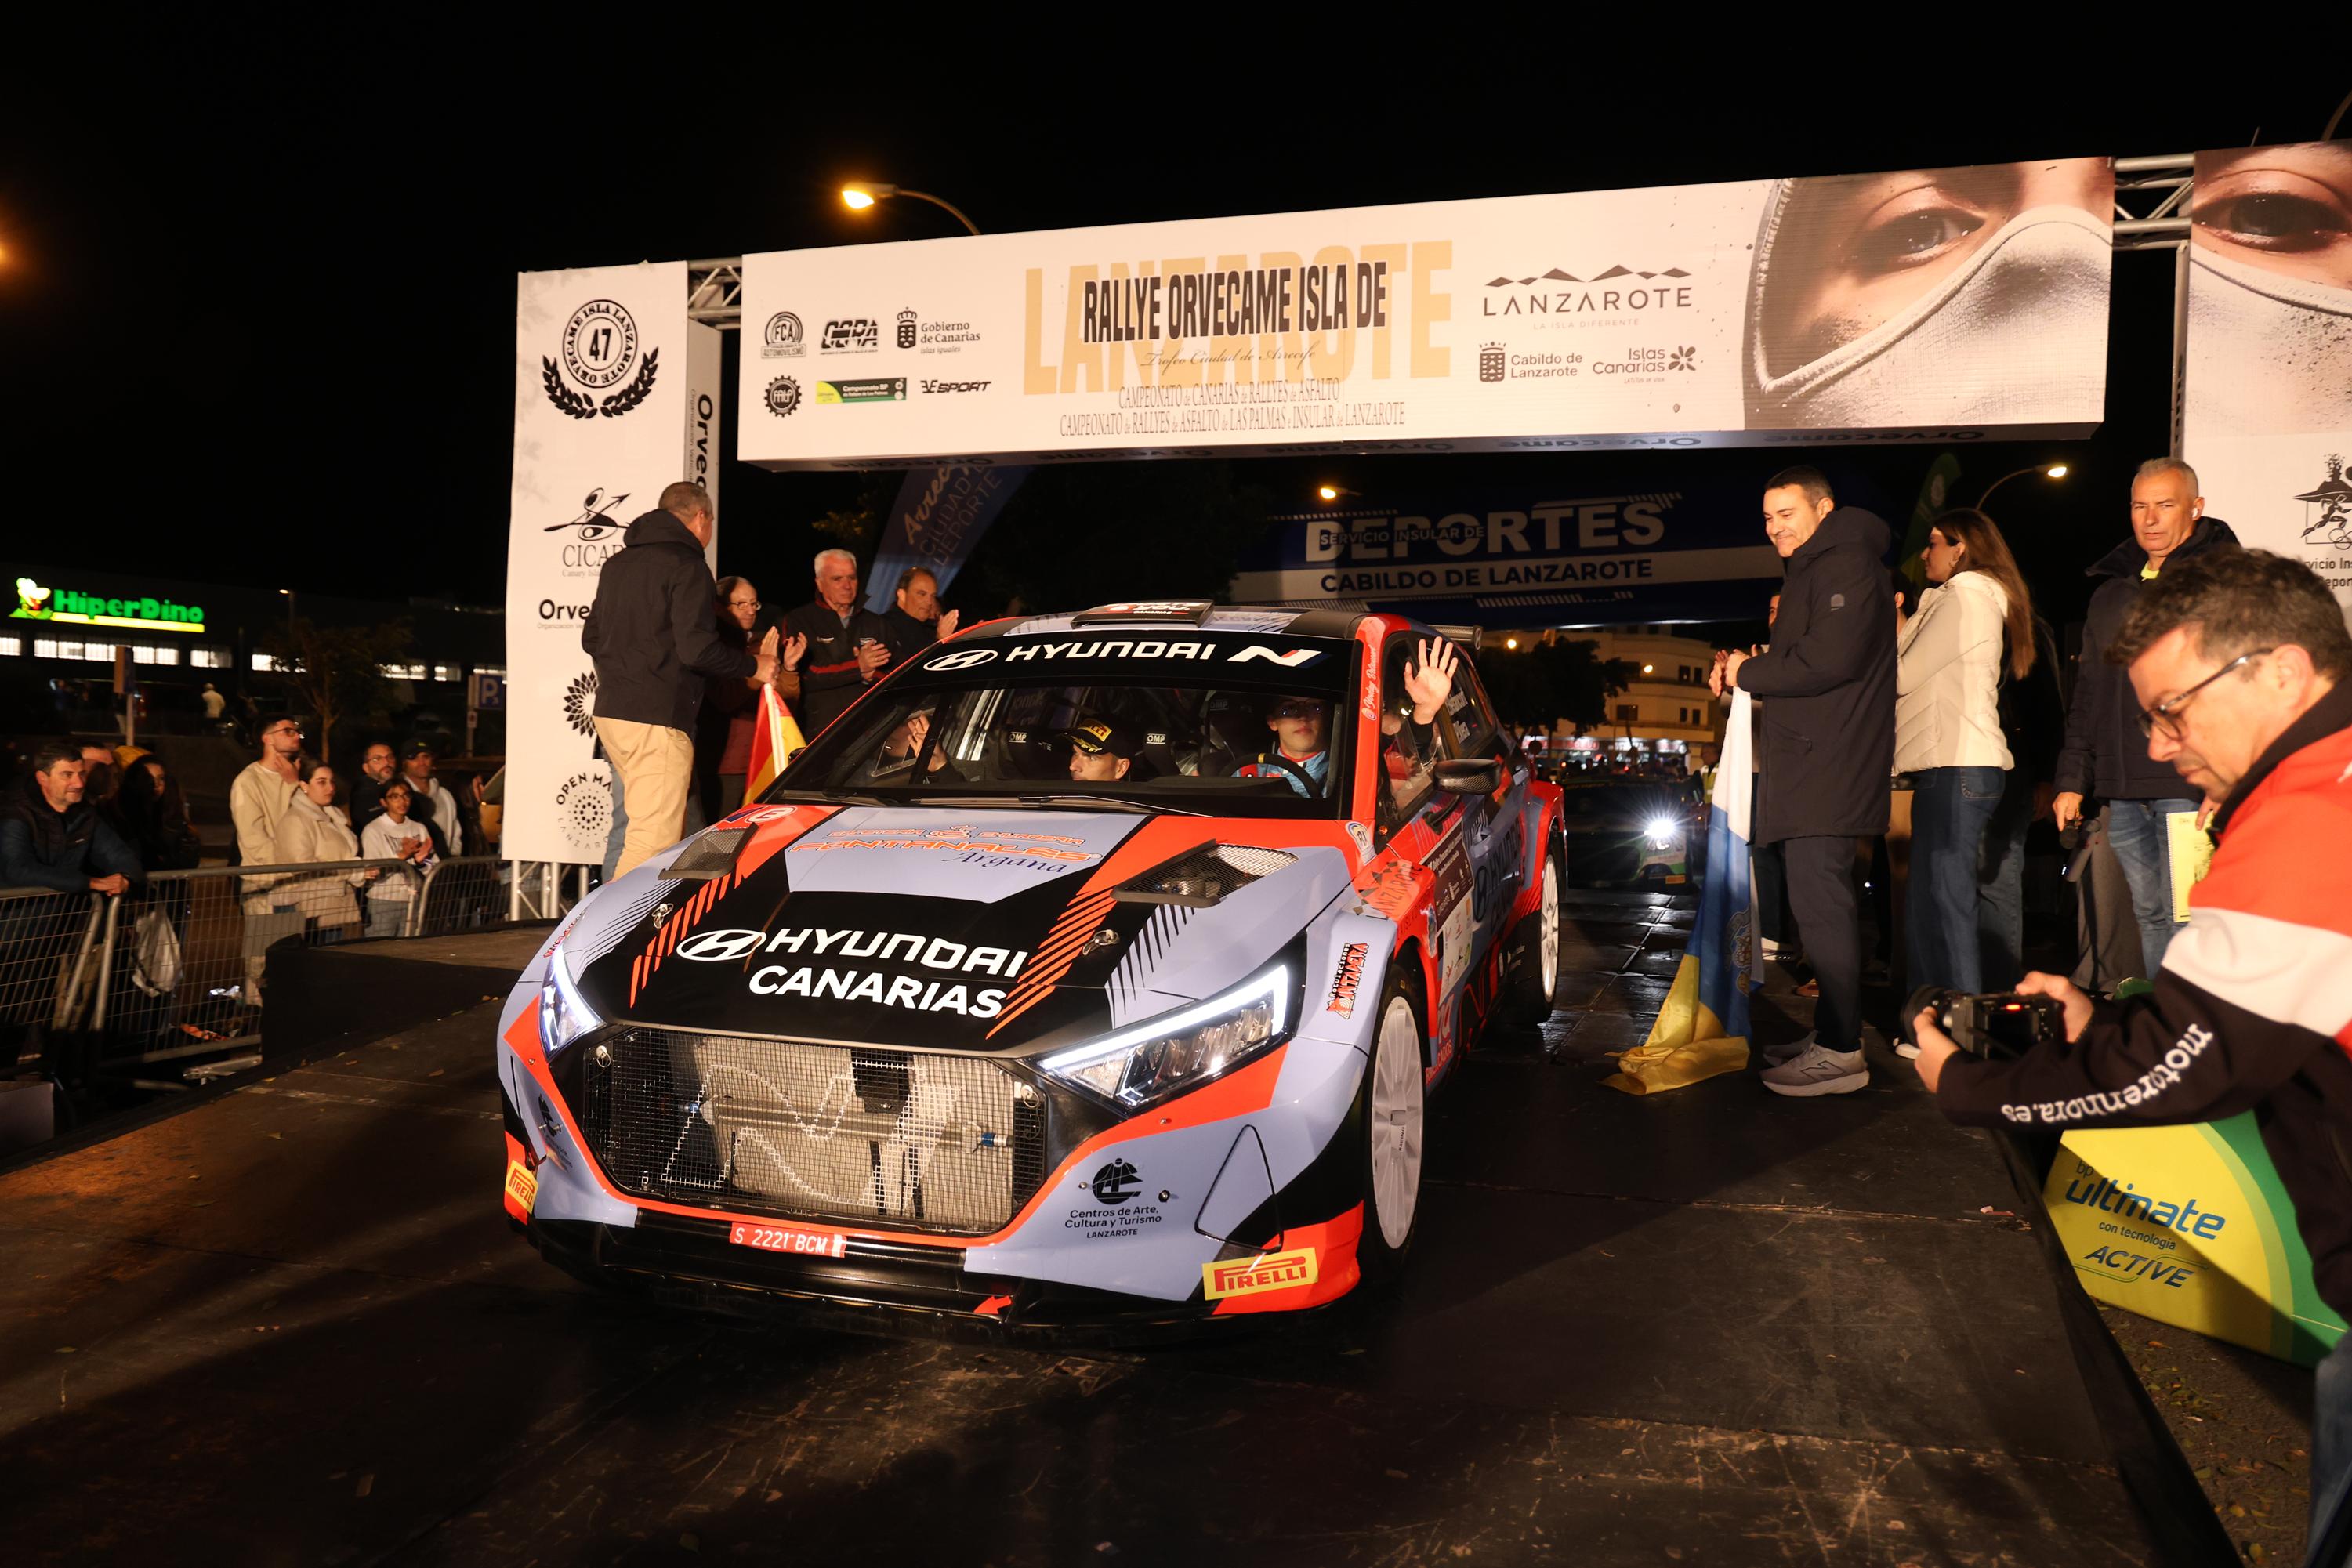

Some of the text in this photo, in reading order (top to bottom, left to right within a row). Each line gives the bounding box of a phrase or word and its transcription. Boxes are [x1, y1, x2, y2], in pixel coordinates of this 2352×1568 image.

[1084, 262, 1386, 343] RALLYE ORVECAME ISLA DE
[1484, 287, 1692, 316] LANZAROTE
[774, 323, 793, 341] FCA
[921, 321, 970, 332] Gobierno
[1533, 318, 1639, 329] LA ISLA DIFERENTE
[589, 328, 612, 361] 47
[920, 332, 981, 343] de Canarias
[1140, 340, 1316, 376] Trofeo Ciudad de Arrecife
[1511, 352, 1583, 365] Cabildo de
[1629, 346, 1665, 360] Islas
[1511, 365, 1578, 379] Lanzarote
[1593, 360, 1665, 375] Canarias
[1118, 384, 1183, 408] CAMPEONATO
[1192, 382, 1239, 406] CANARIAS
[1249, 379, 1288, 404] RALLYES
[1299, 377, 1340, 401] ASFALTO
[1060, 412, 1123, 436] CAMPEONATO
[1133, 411, 1170, 434] RALLYES
[1180, 408, 1220, 432] ASFALTO
[1230, 407, 1248, 430] LAS
[1249, 406, 1286, 430] PALMAS
[1293, 404, 1334, 429] INSULAR
[1345, 402, 1405, 425] LANZAROTE
[696, 394, 712, 488] Orvec
[1305, 502, 1666, 563] DEPORTES
[1320, 525, 1486, 547] SERVICIO INSULAR DE
[1321, 559, 1653, 593] CABILDO DE LANZAROTE
[54, 589, 205, 623] HiperDino
[538, 599, 591, 620] Orve
[1005, 642, 1216, 663] HYUNDAI
[1009, 733, 1027, 742] OMP
[1147, 734, 1165, 744] OMP
[556, 772, 612, 805] OPEN MA
[557, 817, 609, 849] LANZARO
[941, 851, 1067, 873] Argana
[765, 929, 1027, 977] HYUNDAI
[749, 965, 1007, 1018] CANARIAS
[2076, 1161, 2093, 1177] bp
[1070, 1205, 1159, 1219] Centros de Arte,
[2065, 1178, 2225, 1240] ultimate
[1064, 1215, 1162, 1228] Cultura y Turismo
[2099, 1222, 2118, 1234] con
[734, 1227, 828, 1254] S 2221 BCM
[1086, 1228, 1139, 1239] LANZAROTE
[1214, 1256, 1307, 1291] PIRELLI
[2083, 1246, 2194, 1287] ACTIVE
